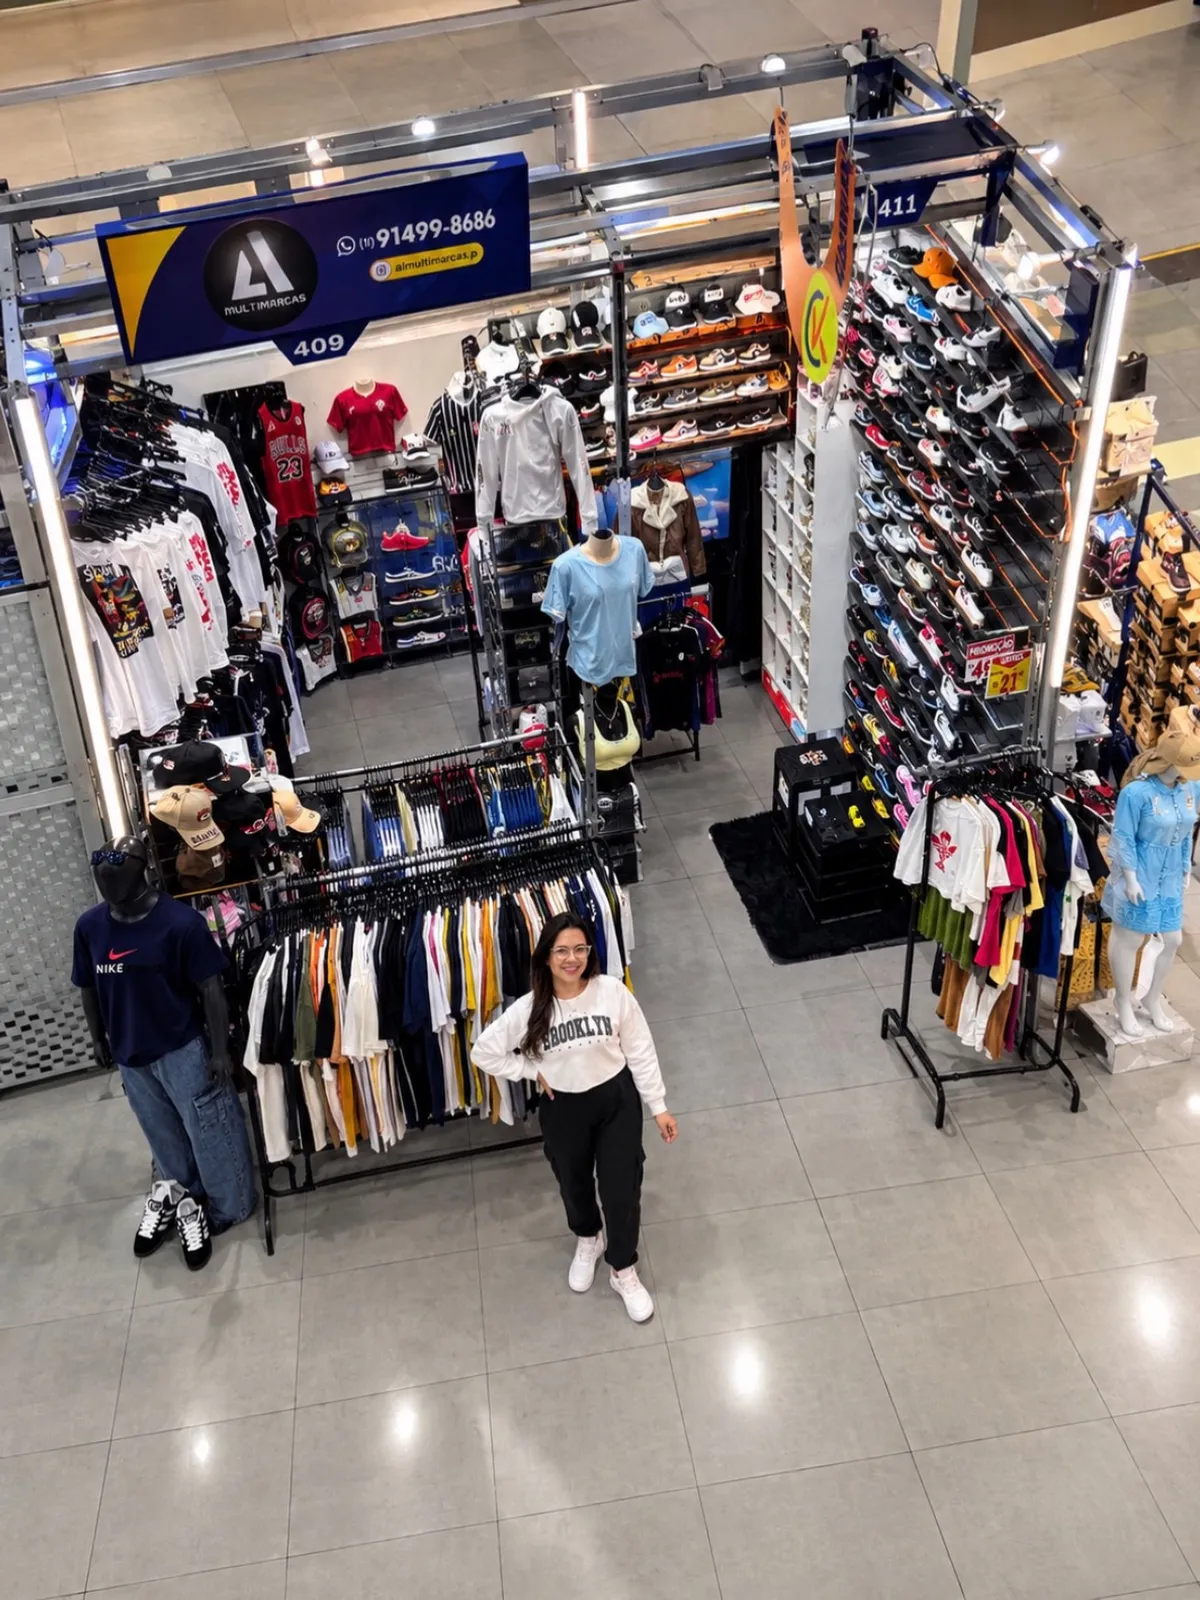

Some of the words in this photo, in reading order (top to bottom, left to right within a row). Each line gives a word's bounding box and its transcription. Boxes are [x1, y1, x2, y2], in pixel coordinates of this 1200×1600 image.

[878, 194, 917, 218] 411
[376, 208, 496, 248] 91499-8686
[224, 293, 307, 316] MULTIMARCAS
[293, 334, 344, 357] 409
[269, 434, 306, 461] BULLS
[276, 455, 303, 483] 23
[96, 962, 124, 974] NIKE
